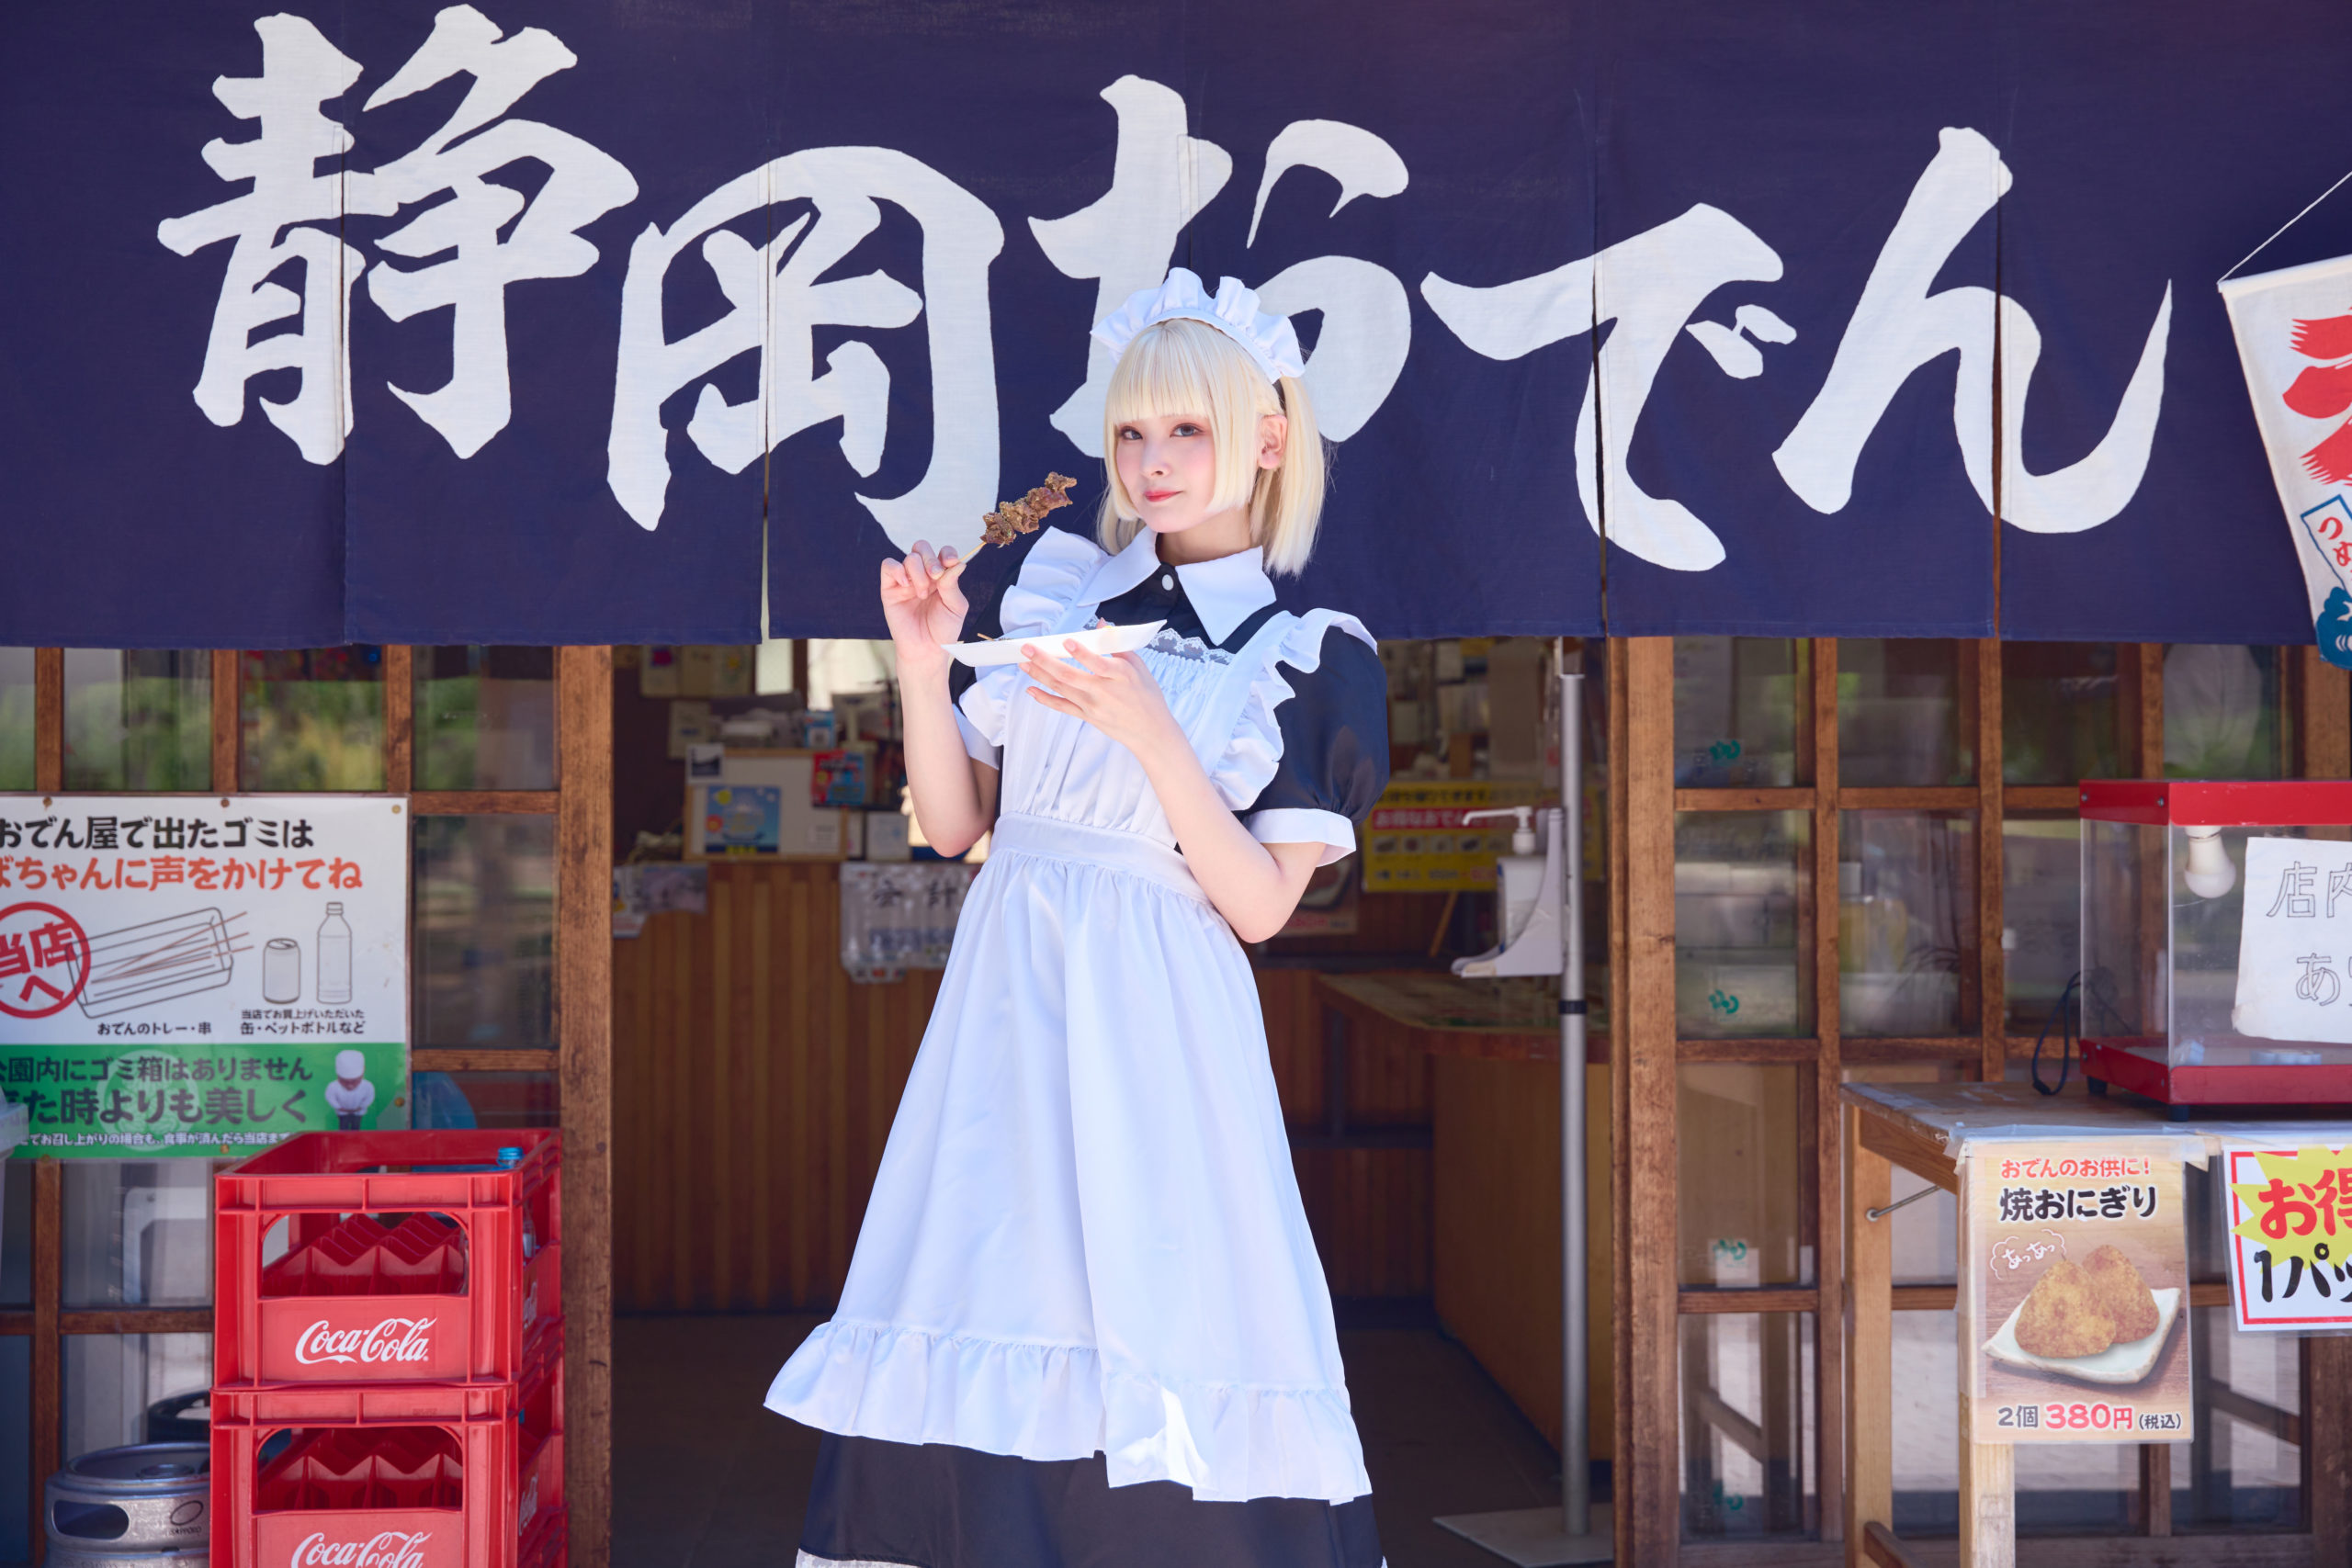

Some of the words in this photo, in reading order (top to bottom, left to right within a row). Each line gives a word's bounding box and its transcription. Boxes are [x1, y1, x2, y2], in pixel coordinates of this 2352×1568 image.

[157, 5, 2173, 571] 静岡おでん
[0, 816, 313, 850] おでん屋で出たゴミは
[18, 975, 65, 1003] へ
[2295, 952, 2352, 1007] あ
[97, 1021, 212, 1035] おでんのトレー・串
[241, 1021, 366, 1035] 缶・ペットボトルなど
[4, 1087, 307, 1125] た時よりも美しく
[1999, 1185, 2156, 1222] 焼おにぎり
[295, 1316, 437, 1365] Coca-Cola
[1997, 1404, 2039, 1428] 2個
[2045, 1404, 2132, 1429] 380円
[2138, 1413, 2181, 1429] (税込)
[290, 1531, 433, 1568] Coca-Cola
